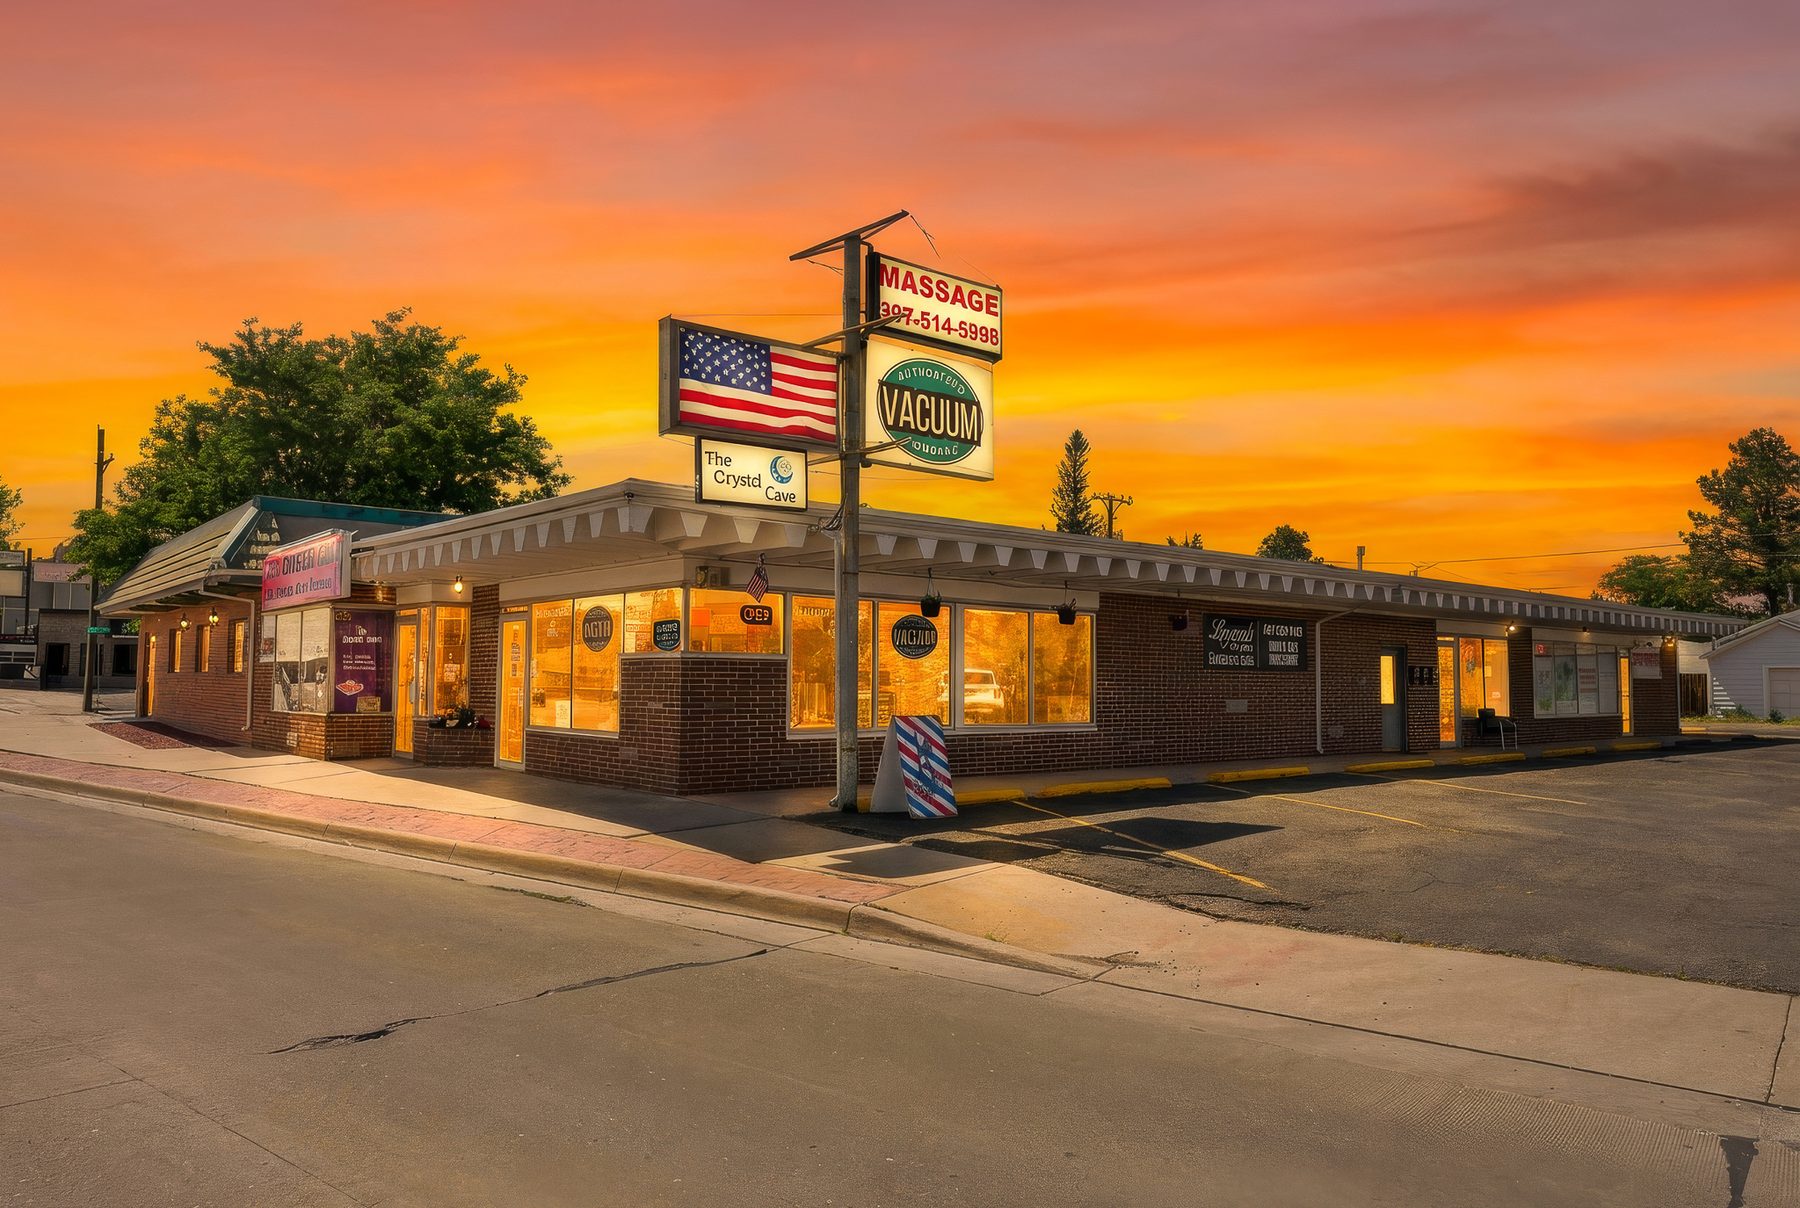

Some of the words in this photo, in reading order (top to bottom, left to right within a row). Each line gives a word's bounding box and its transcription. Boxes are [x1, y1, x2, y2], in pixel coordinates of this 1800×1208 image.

[880, 263, 998, 317] MASSAGE
[882, 386, 978, 441] VACUUM
[705, 451, 732, 467] The
[765, 486, 796, 503] Cave
